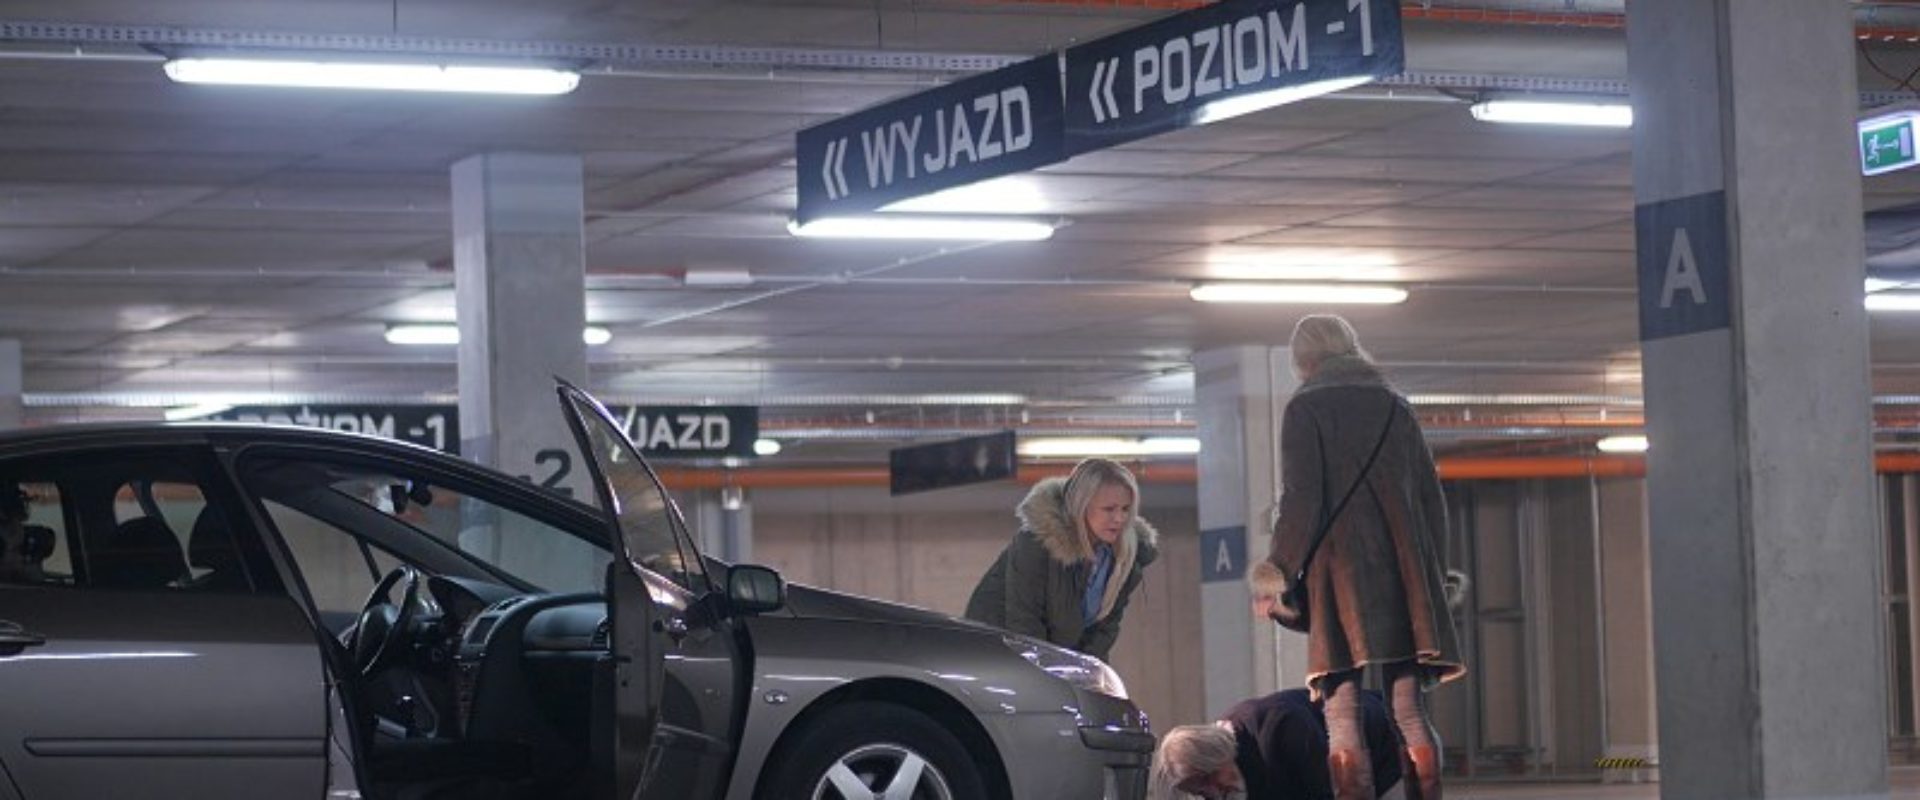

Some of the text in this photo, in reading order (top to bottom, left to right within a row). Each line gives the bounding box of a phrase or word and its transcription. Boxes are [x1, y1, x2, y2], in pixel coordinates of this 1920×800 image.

[1134, 0, 1374, 113] POZIOM -1
[861, 86, 1033, 189] WYJAZD
[1660, 227, 1708, 308] A
[408, 414, 445, 450] -1
[1216, 538, 1232, 573] A
